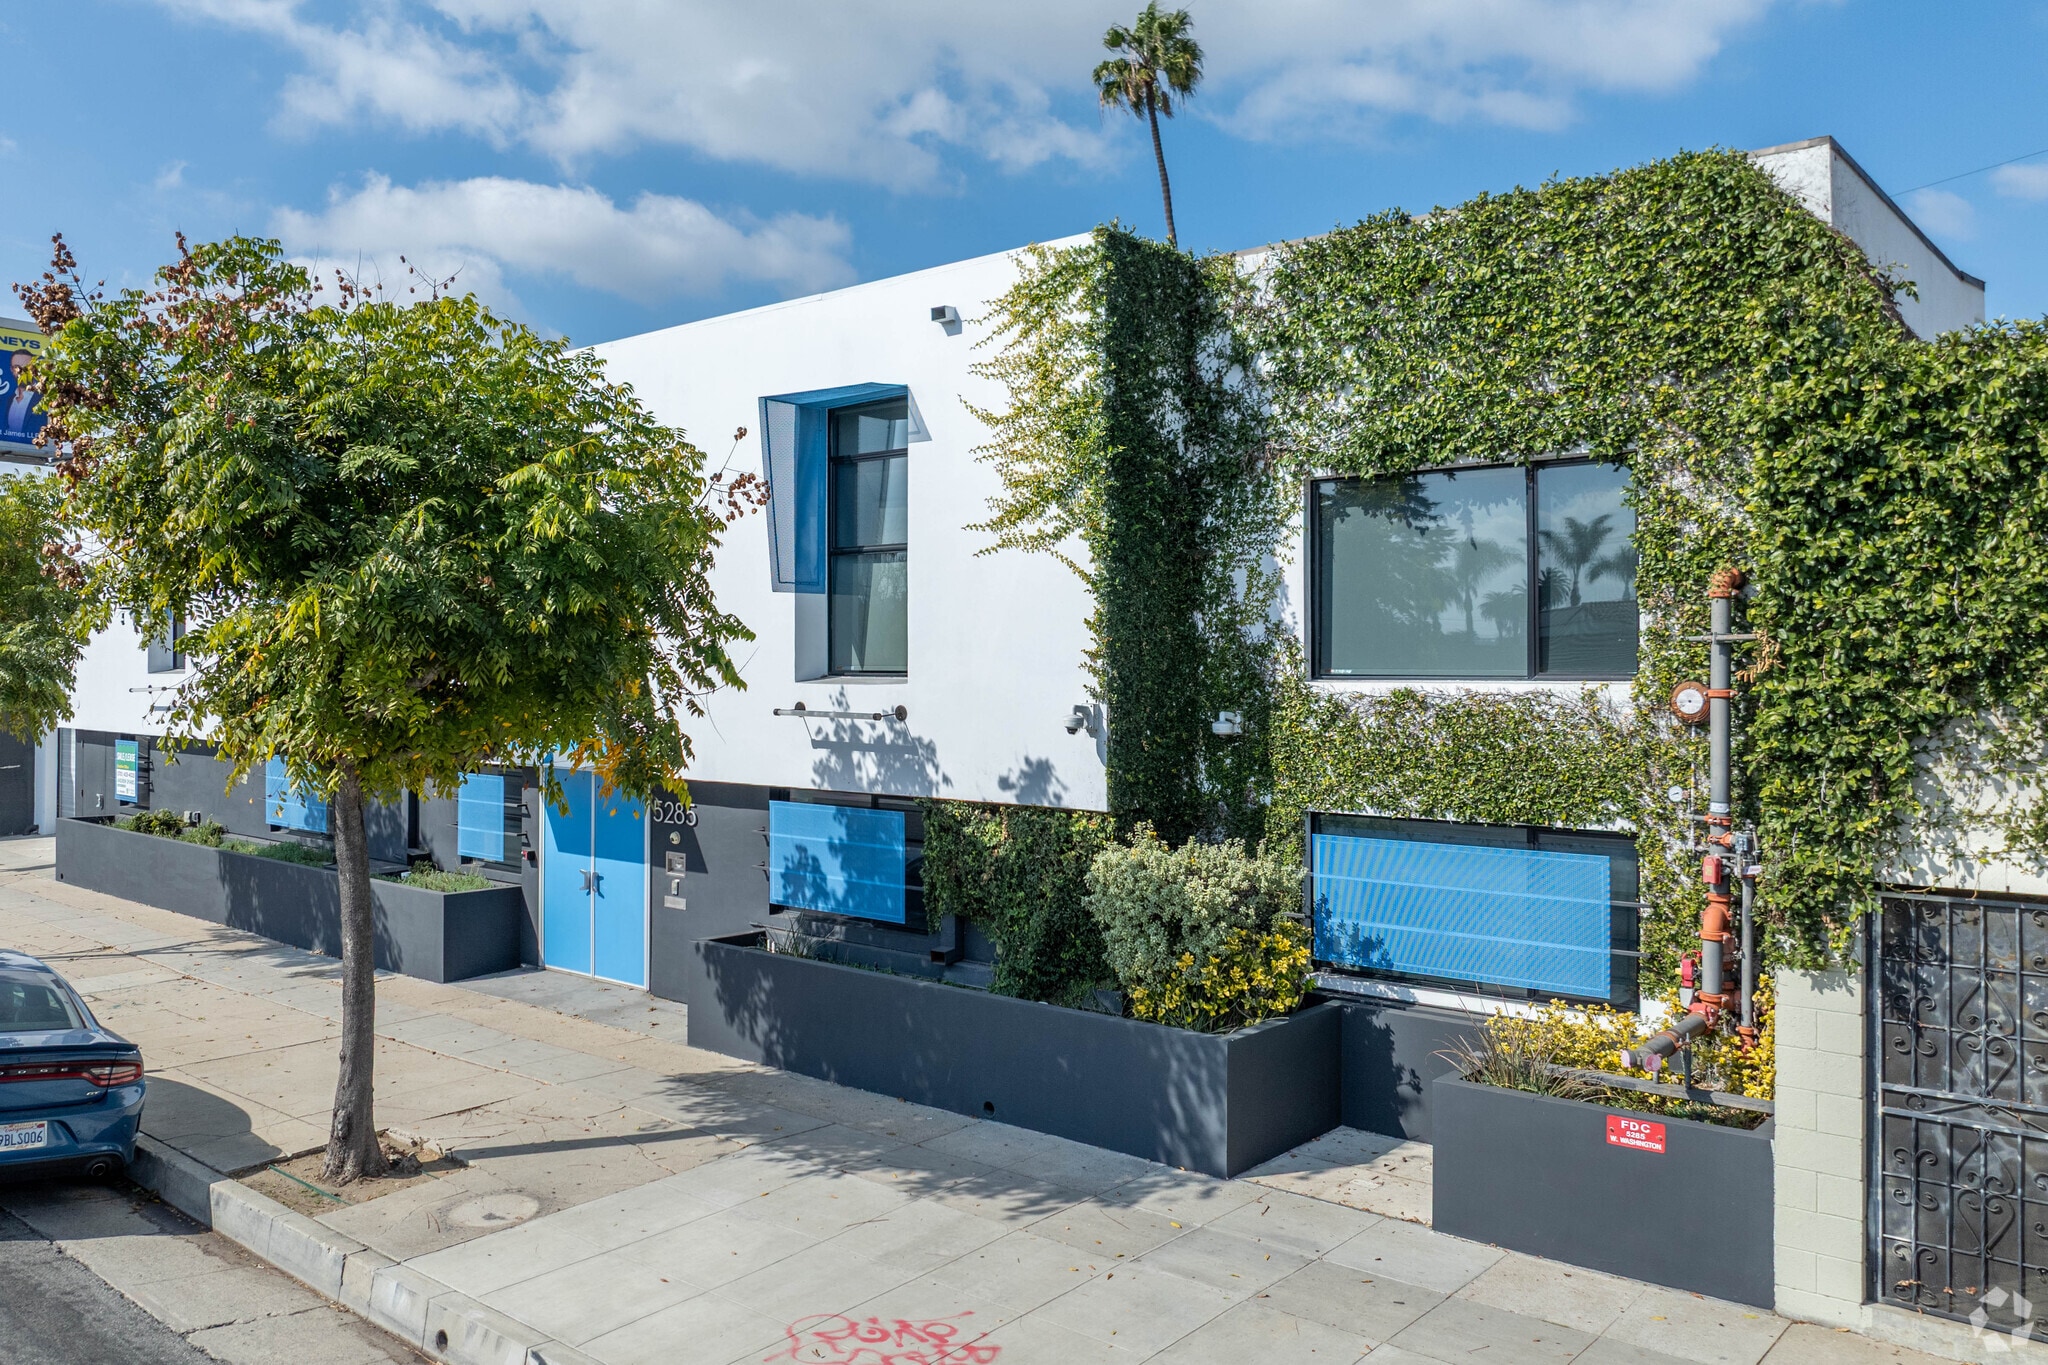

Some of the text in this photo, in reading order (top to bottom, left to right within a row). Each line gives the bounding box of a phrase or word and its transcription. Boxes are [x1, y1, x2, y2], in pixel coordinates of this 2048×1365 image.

[653, 800, 697, 826] 5285
[1621, 1120, 1650, 1133] FDC
[1626, 1131, 1646, 1140] 5285
[1620, 1136, 1662, 1150] WASHINGTON
